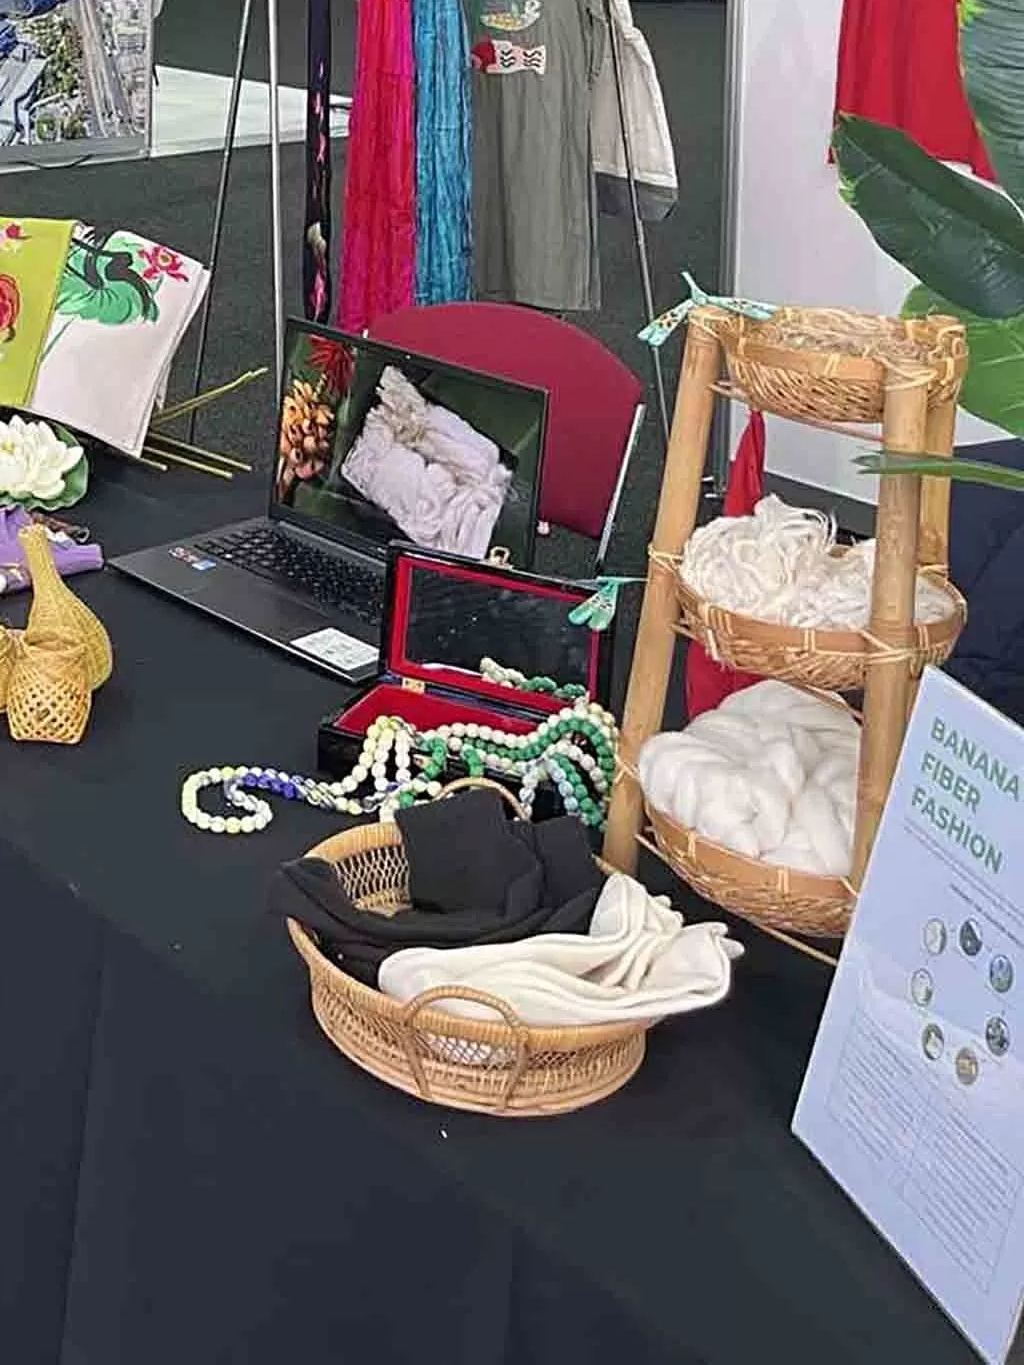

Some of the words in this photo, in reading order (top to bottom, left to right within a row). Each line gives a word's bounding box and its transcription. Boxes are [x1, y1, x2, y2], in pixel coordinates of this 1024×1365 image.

[921, 752, 982, 814] FIBER
[930, 716, 1021, 803] BANANA
[911, 786, 1003, 875] FASHION
